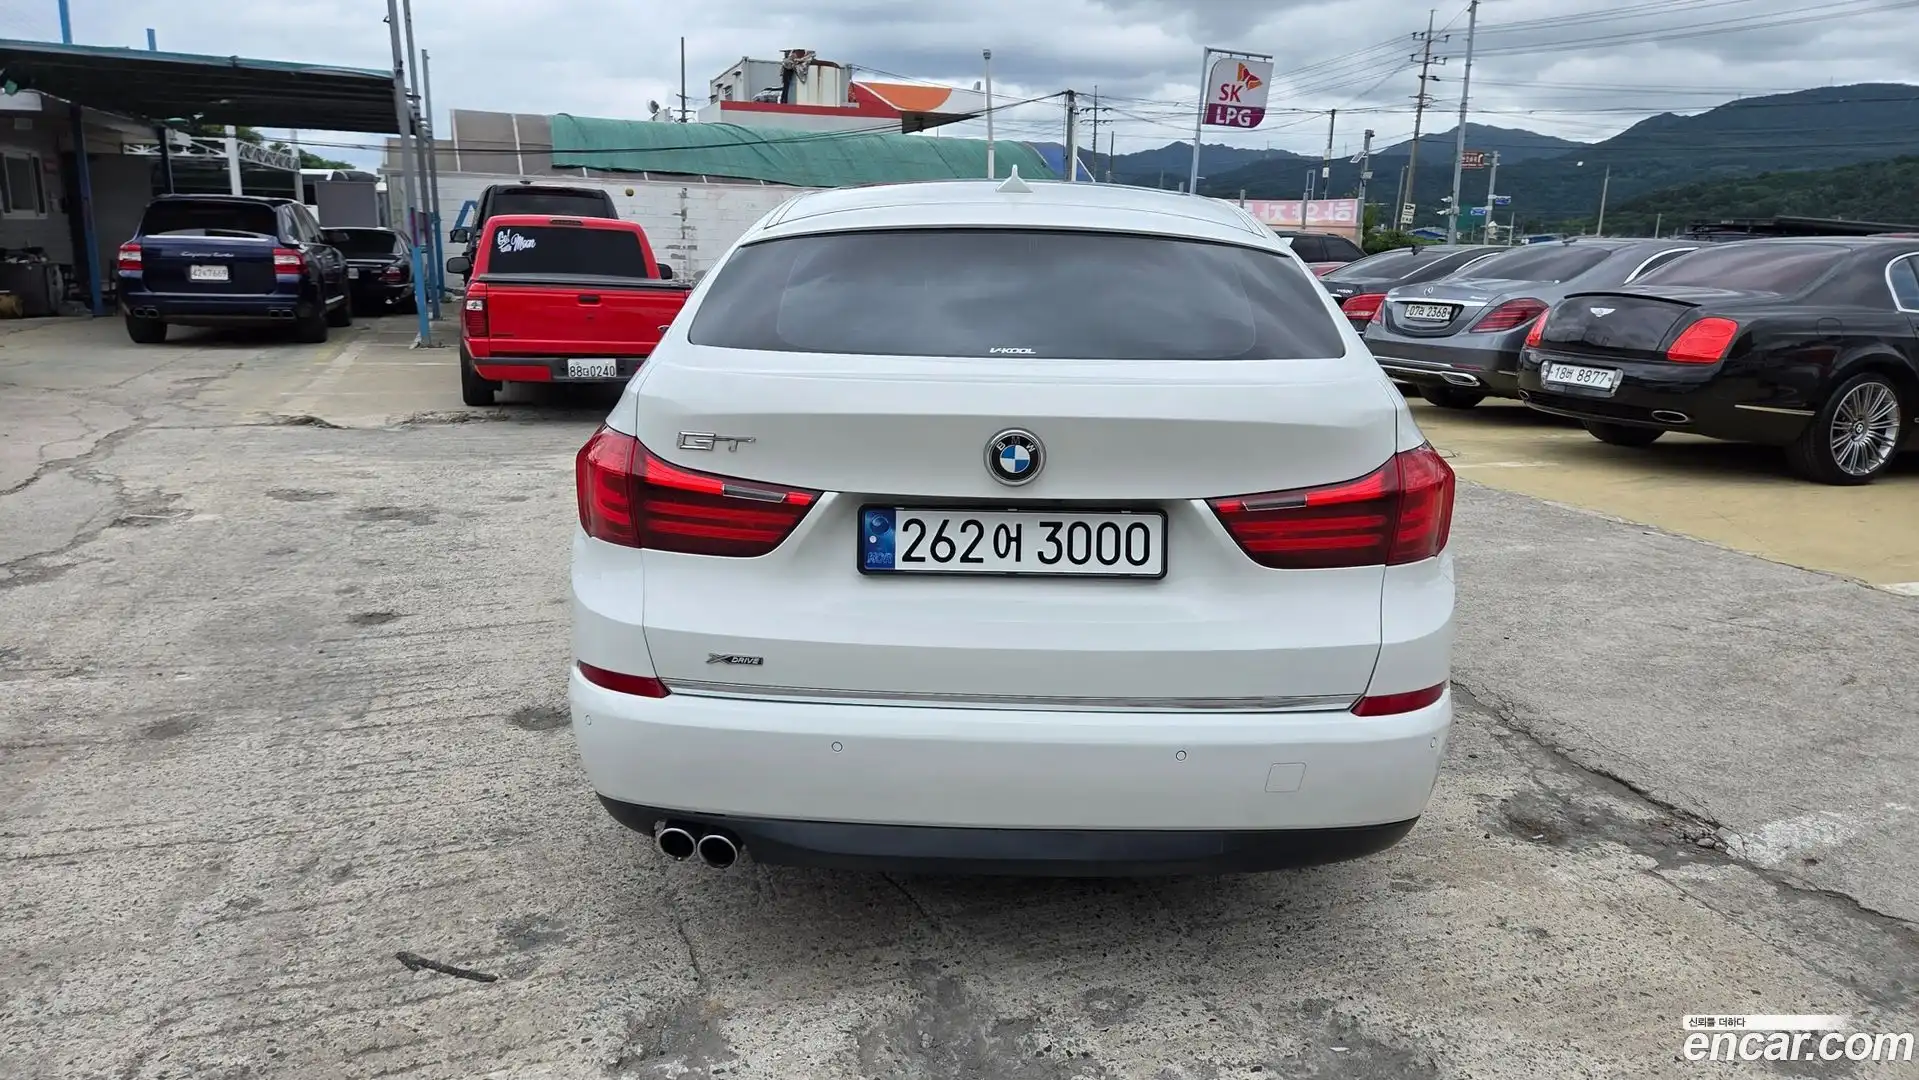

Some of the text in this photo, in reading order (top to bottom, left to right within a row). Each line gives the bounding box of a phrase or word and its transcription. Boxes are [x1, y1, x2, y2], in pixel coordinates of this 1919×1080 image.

[1219, 83, 1243, 102] SK
[1215, 106, 1251, 126] LPG
[1426, 306, 1448, 318] 2368
[1576, 369, 1609, 384] 8877
[677, 431, 756, 452] GT
[996, 436, 1036, 452] BMW
[1037, 520, 1150, 566] 3000
